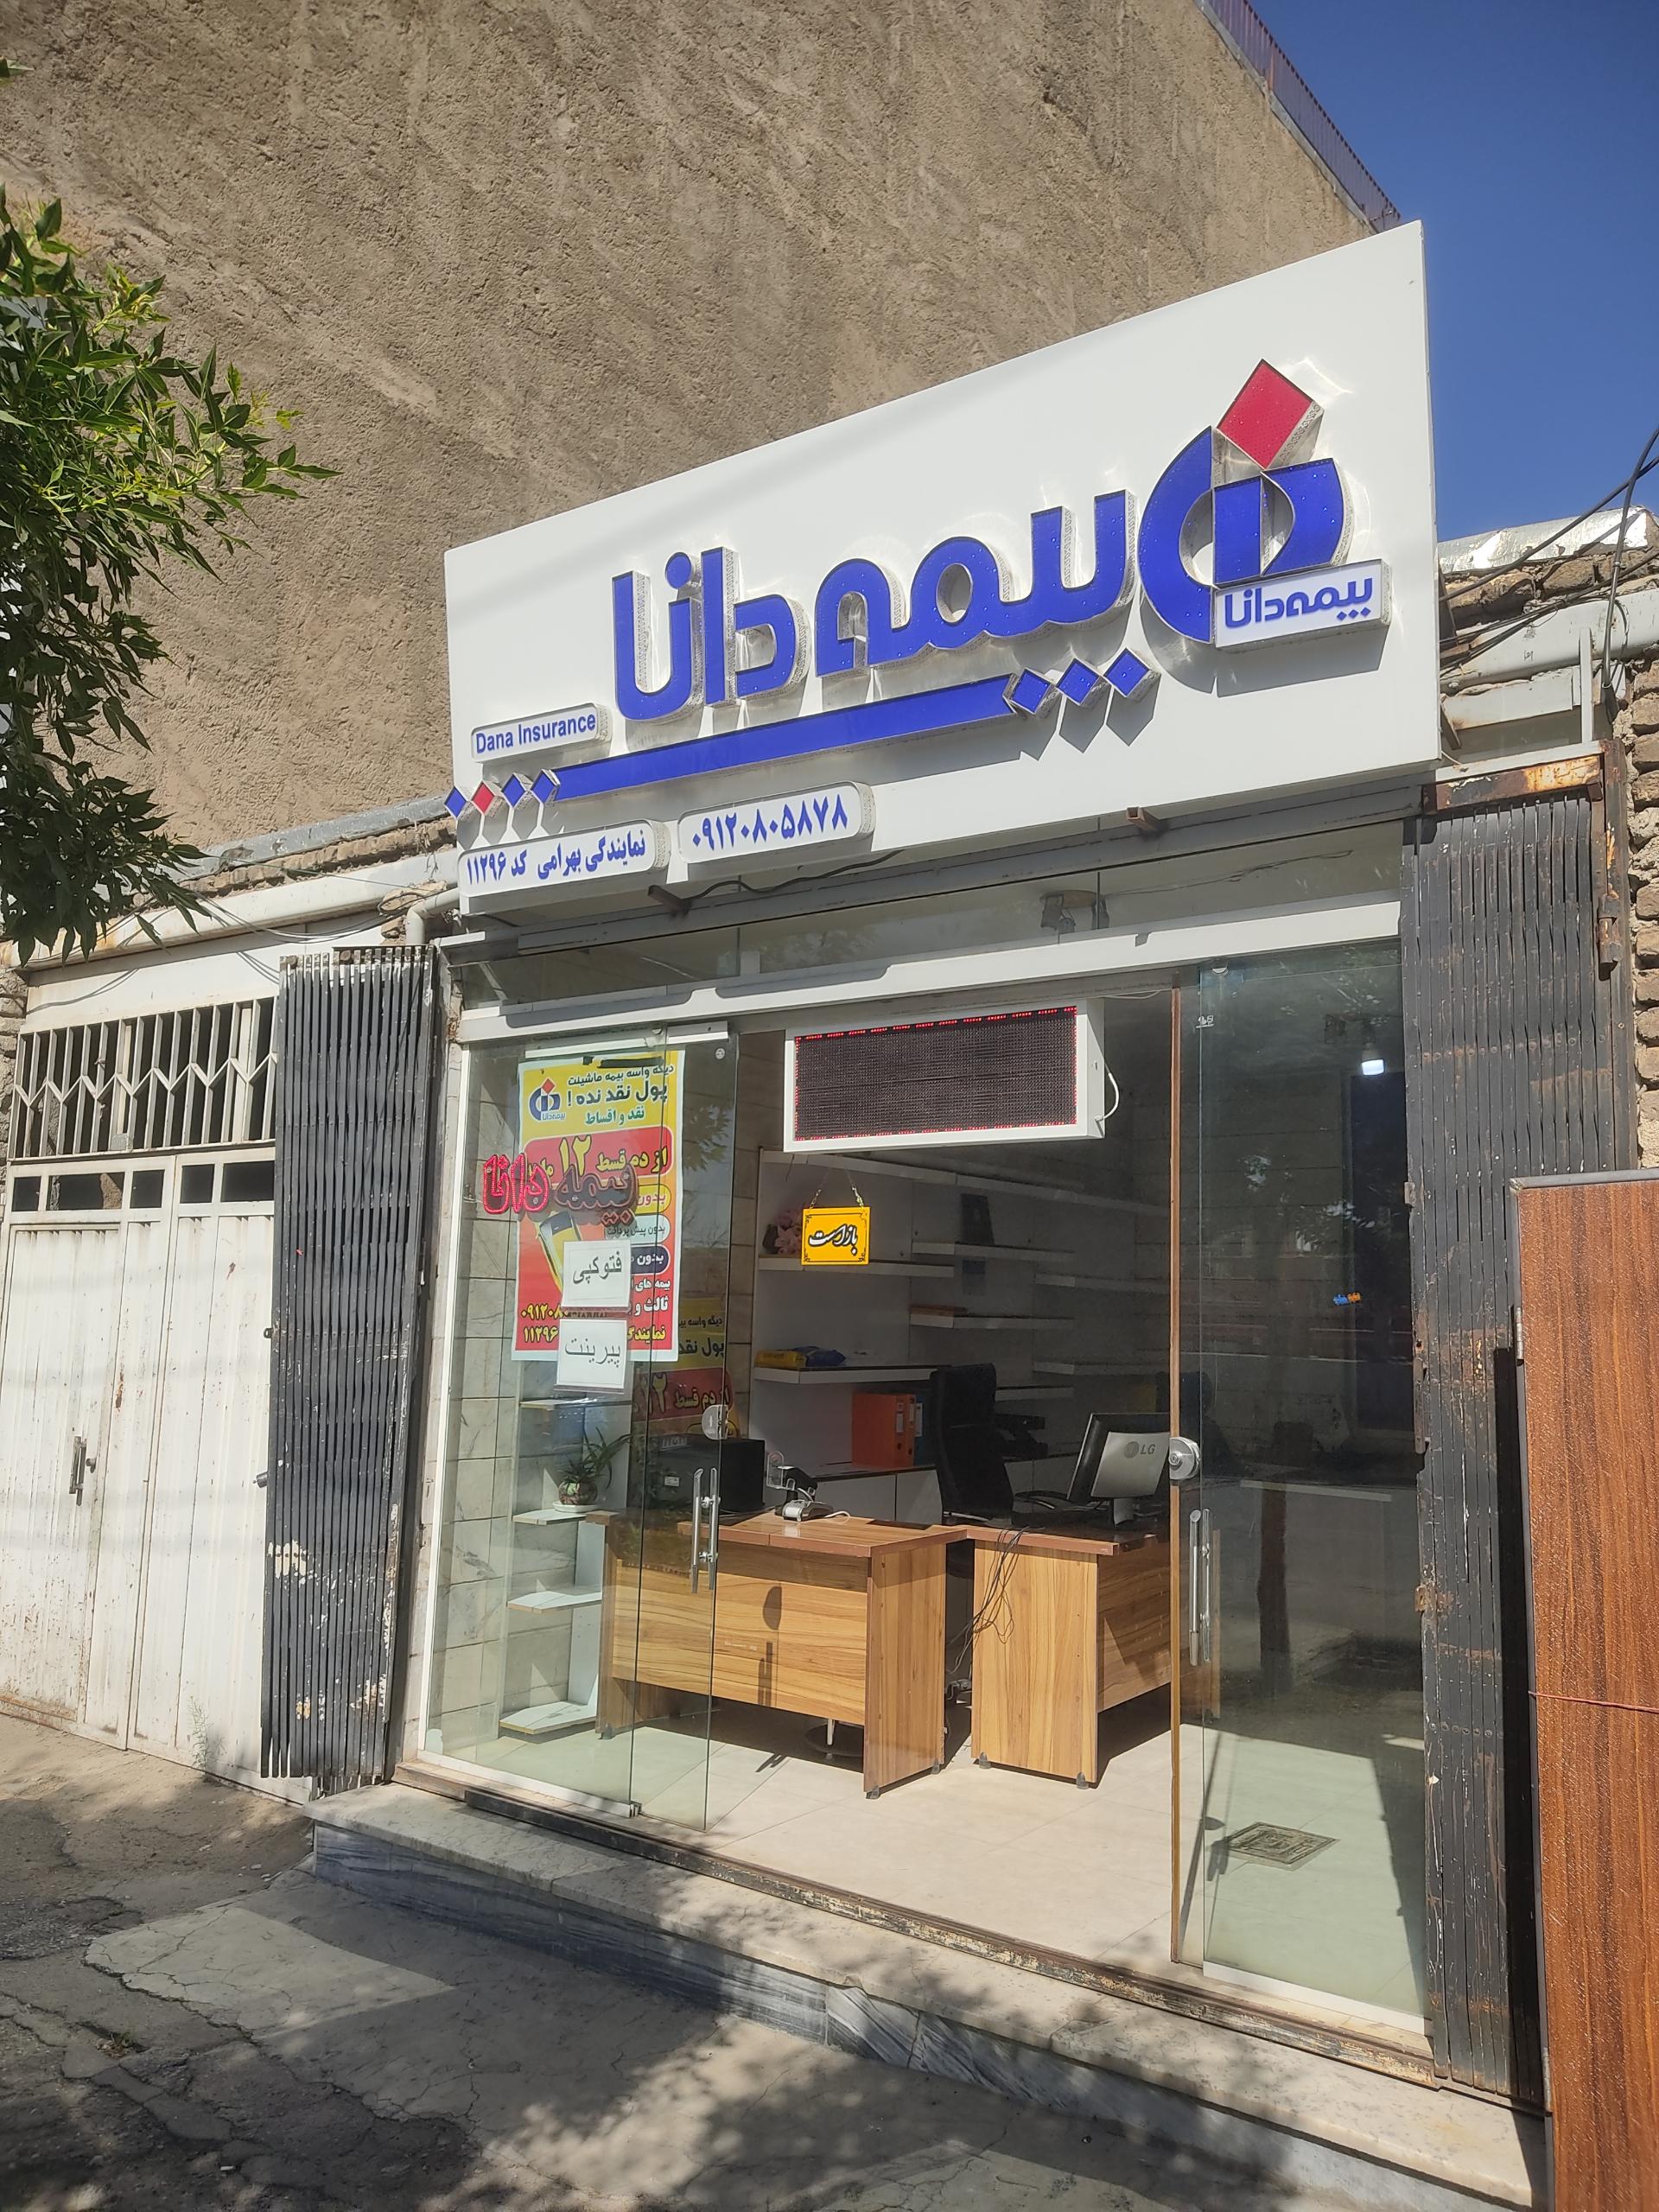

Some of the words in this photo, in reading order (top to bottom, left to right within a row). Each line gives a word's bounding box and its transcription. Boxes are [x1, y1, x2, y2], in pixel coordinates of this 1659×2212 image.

[816, 490, 1148, 713] بیمه
[1224, 588, 1285, 629] دانا
[1286, 578, 1373, 621] بیمه
[613, 548, 798, 721] دانا
[476, 732, 513, 753] Dana
[518, 713, 595, 745] Insurance
[692, 794, 849, 850] ۰۹۱۲۰۸۰۵۸۷۸
[511, 849, 527, 876] کد
[537, 843, 582, 880] بهرامی
[585, 830, 645, 873] نمایندگی
[467, 852, 507, 885] ۱۱۲۹۶
[568, 1074, 602, 1086] ماشینت
[605, 1072, 624, 1082] بیمه
[626, 1066, 650, 1078] واسه
[576, 1090, 601, 1106] نده
[606, 1085, 632, 1103] نقد
[636, 1080, 667, 1103] پول
[585, 1109, 617, 1126] اقساط
[627, 1105, 645, 1121] نقد
[558, 1135, 592, 1178] ۱۲
[596, 1148, 626, 1172] قسط
[651, 1146, 668, 1173] از
[482, 1154, 550, 1215] دانا
[555, 1163, 639, 1226] بیمه
[635, 1193, 666, 1206] بدون
[648, 1226, 665, 1236] بدون
[573, 1250, 622, 1285] فتوکپی
[636, 1253, 664, 1266] بدون
[635, 1278, 652, 1292] های
[654, 1280, 671, 1291] بیمه
[633, 1303, 642, 1316] و
[643, 1295, 670, 1312] ثالث
[524, 1325, 560, 1343] ۱۱۲۹۶
[626, 1325, 666, 1344] نمایندگ
[565, 1338, 622, 1369] پیرینت
[674, 1387, 700, 1409] قسط
[1141, 1444, 1156, 1455] LG
